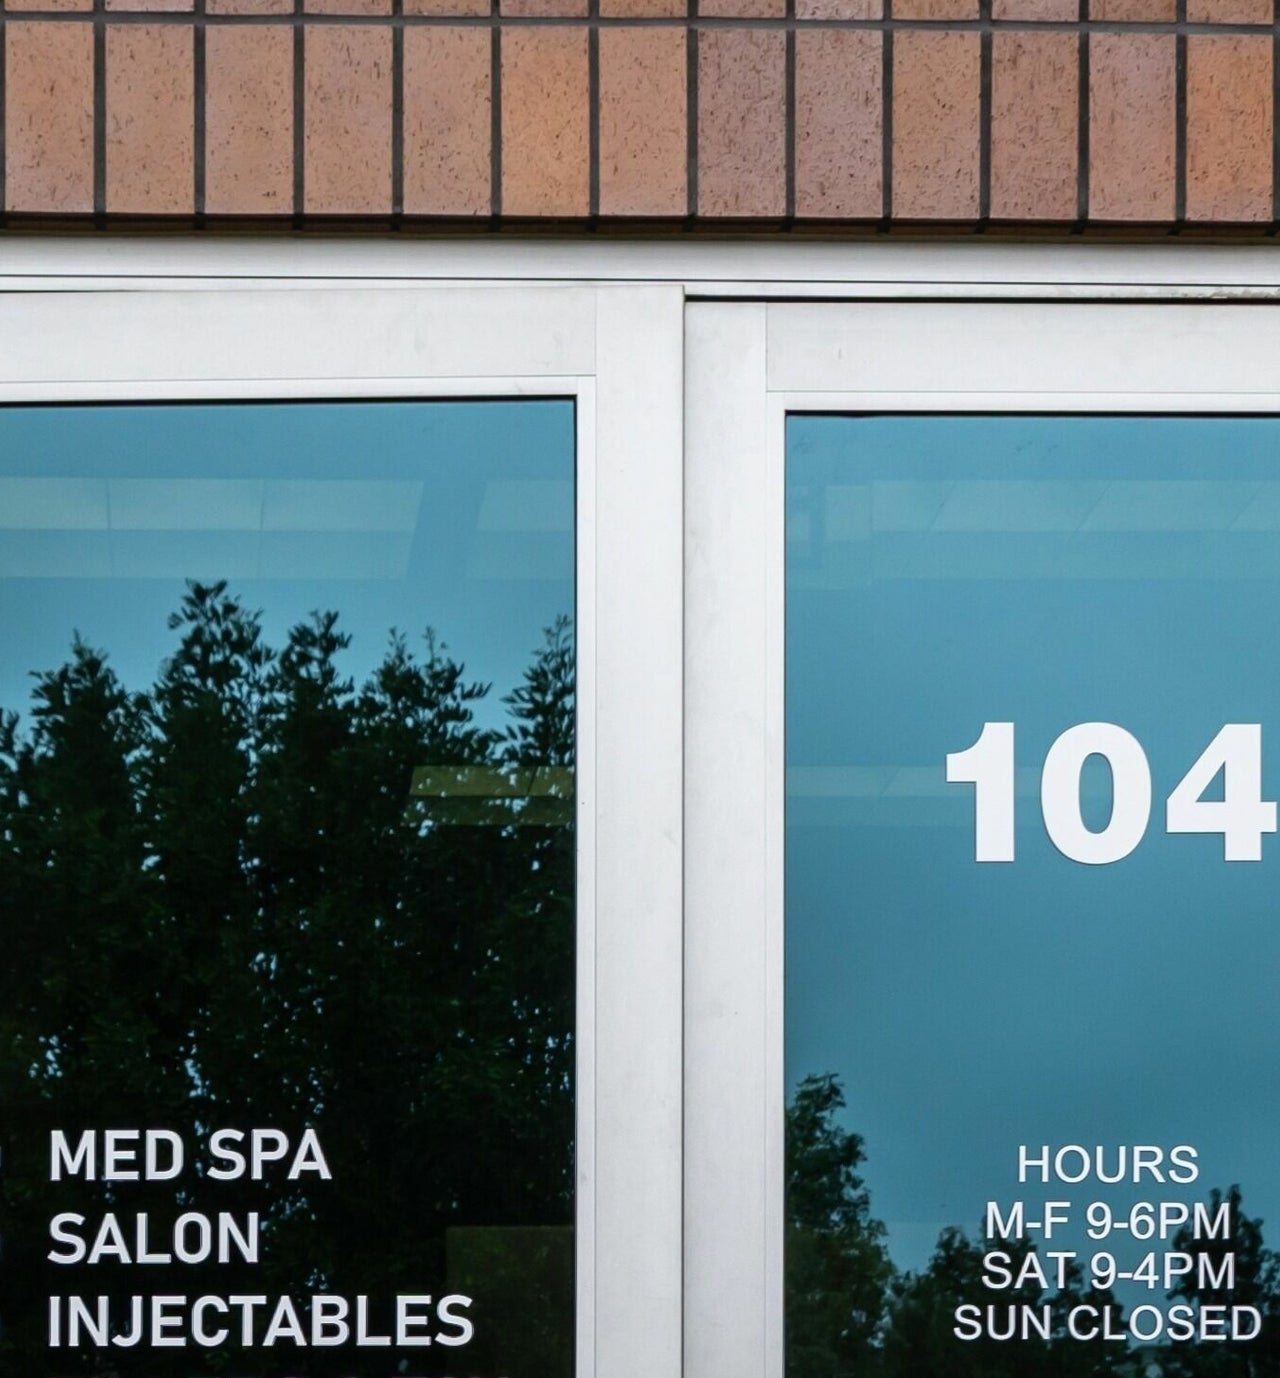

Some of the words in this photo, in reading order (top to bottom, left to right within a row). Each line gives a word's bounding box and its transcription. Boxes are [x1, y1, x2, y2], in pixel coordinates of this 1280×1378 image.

[947, 722, 1277, 864] 104
[52, 1130, 182, 1180] MED
[208, 1129, 331, 1179] SPA
[1020, 1145, 1198, 1183] HOURS
[48, 1213, 258, 1263] SALON
[988, 1202, 1070, 1238] M-F
[1087, 1202, 1229, 1239] 9-6PM
[982, 1252, 1076, 1288] SAT
[1092, 1252, 1233, 1289] 9-4PM
[50, 1295, 472, 1346] INJECTABLES
[954, 1305, 1050, 1340] SUN
[1069, 1305, 1260, 1340] CLOSED
